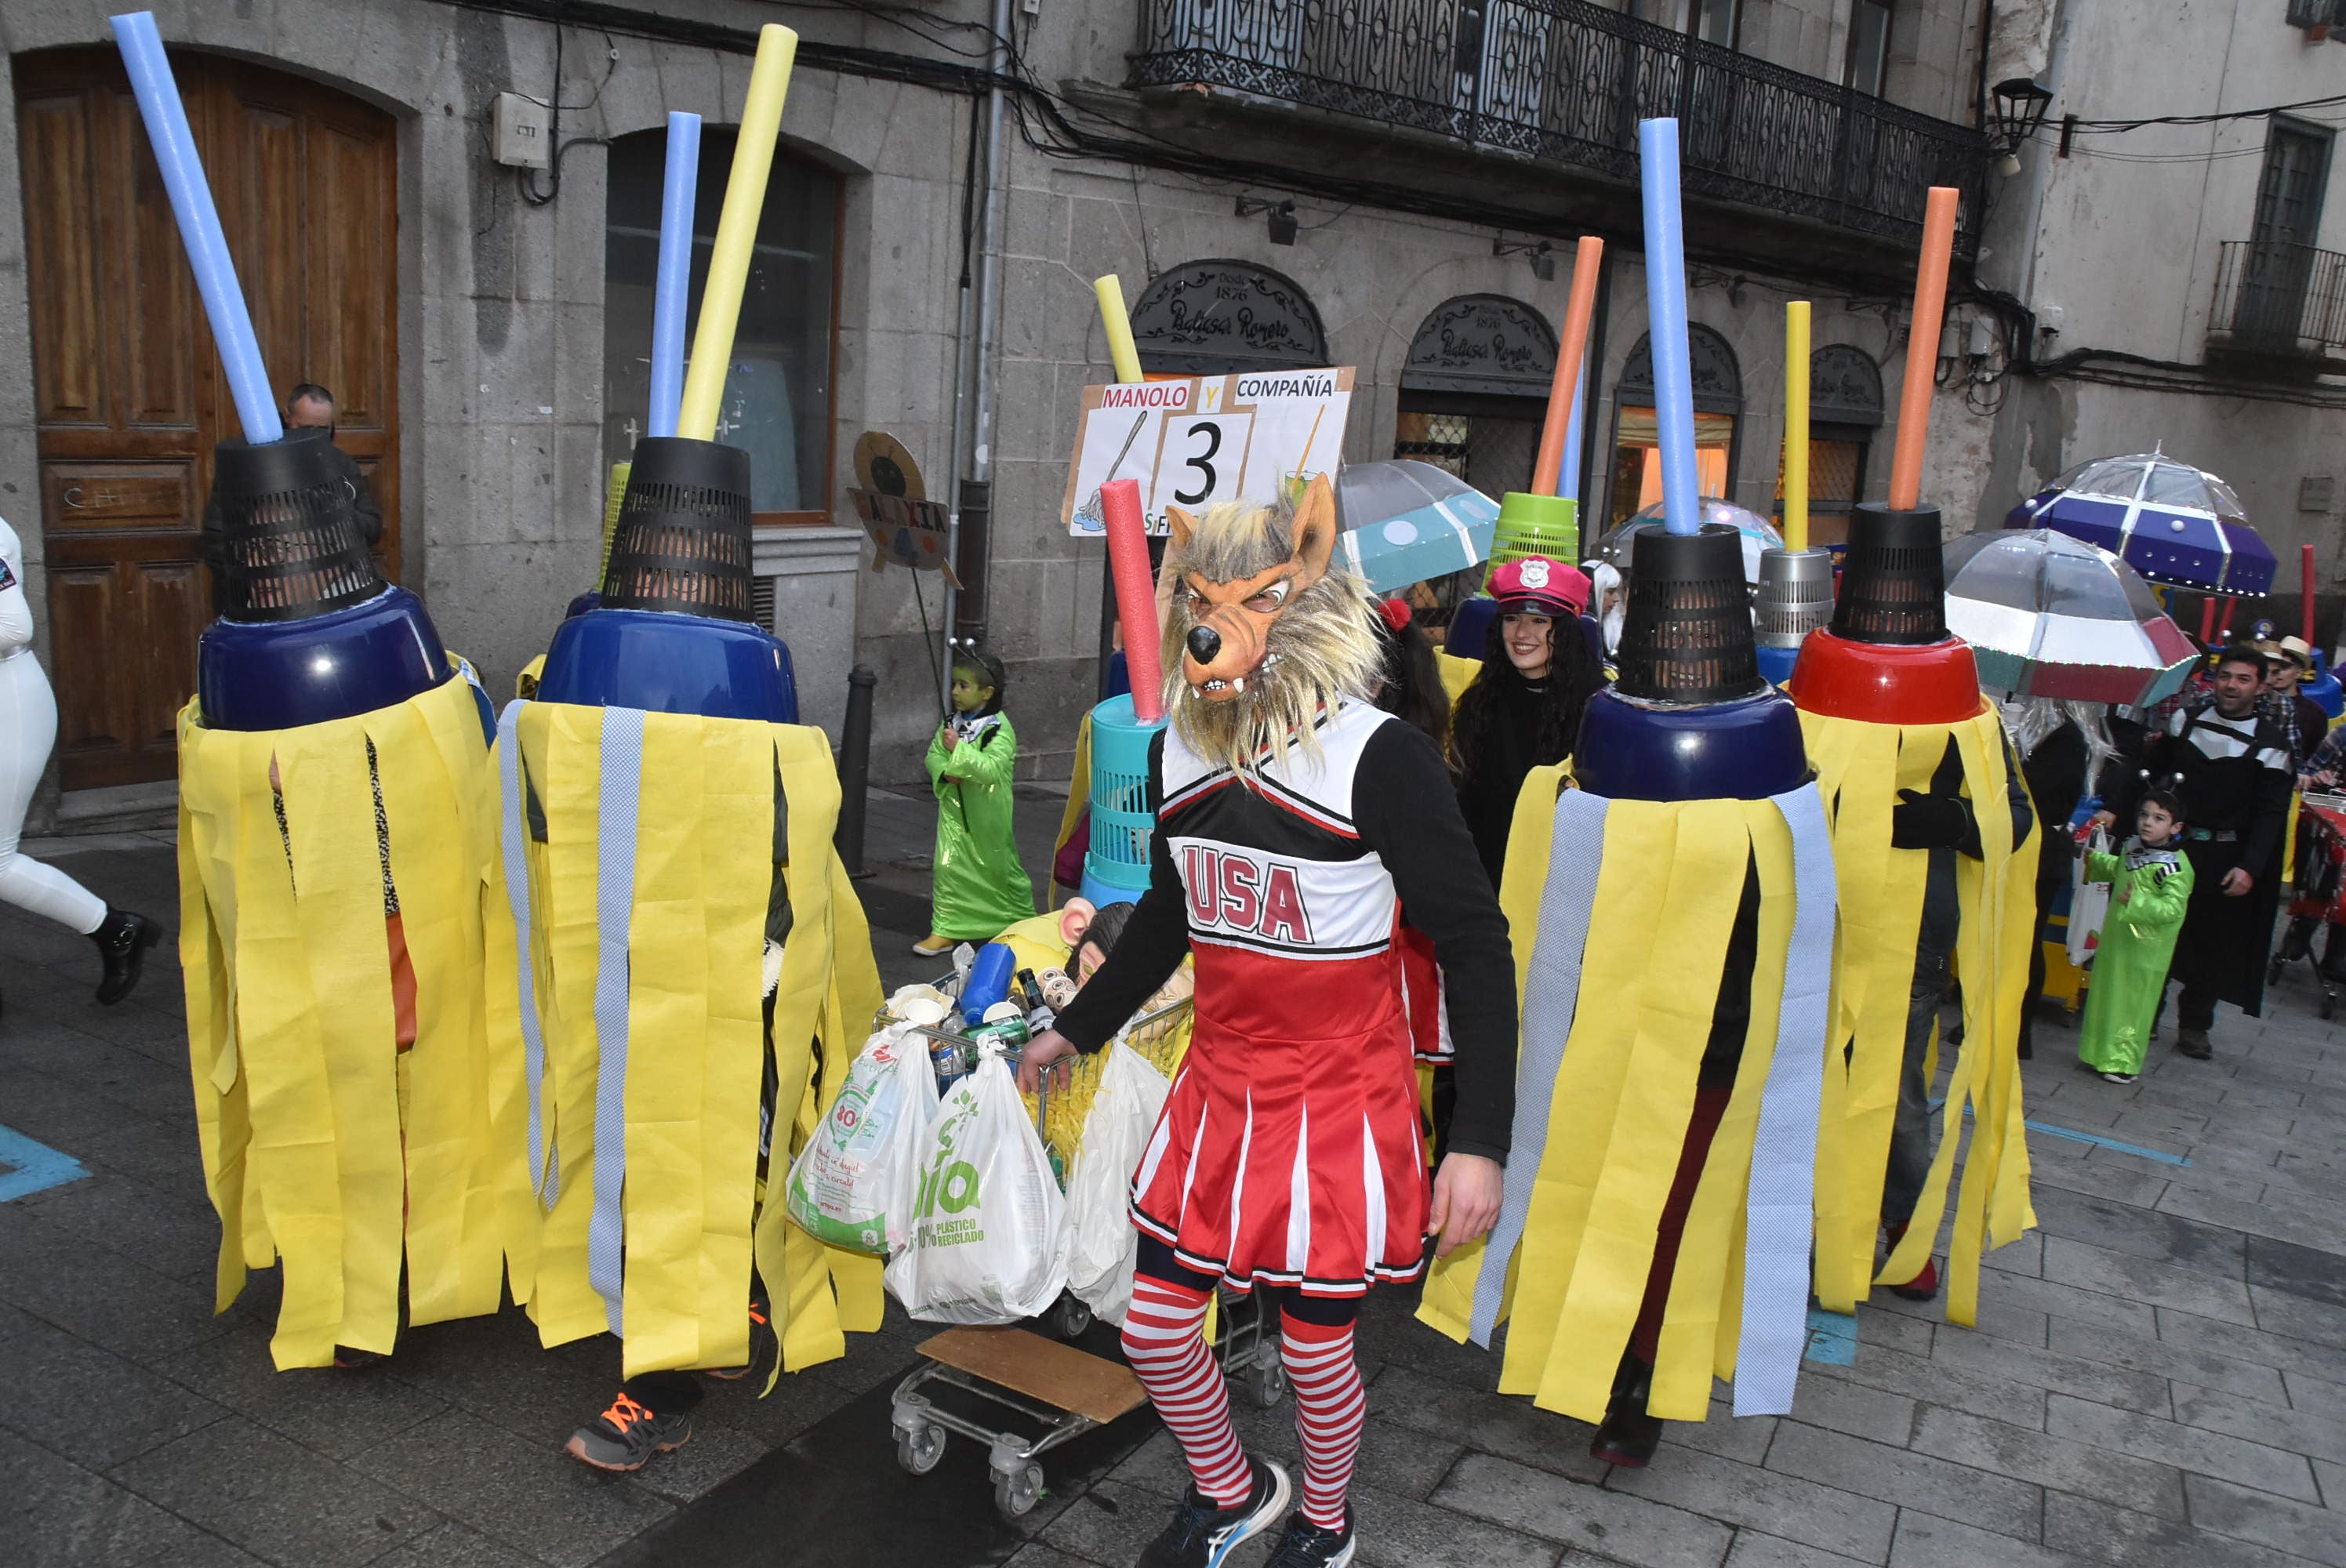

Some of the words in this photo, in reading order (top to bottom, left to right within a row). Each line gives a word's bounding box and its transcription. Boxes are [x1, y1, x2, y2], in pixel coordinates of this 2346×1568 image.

[1216, 285, 1248, 302] 1876
[1102, 386, 1188, 408] MANOLO
[1205, 385, 1220, 408] Y
[1237, 375, 1333, 397] COMPAÑÍA
[1174, 421, 1222, 505] 3
[1182, 845, 1316, 945] USA
[937, 1229, 984, 1247] RECICLADO
